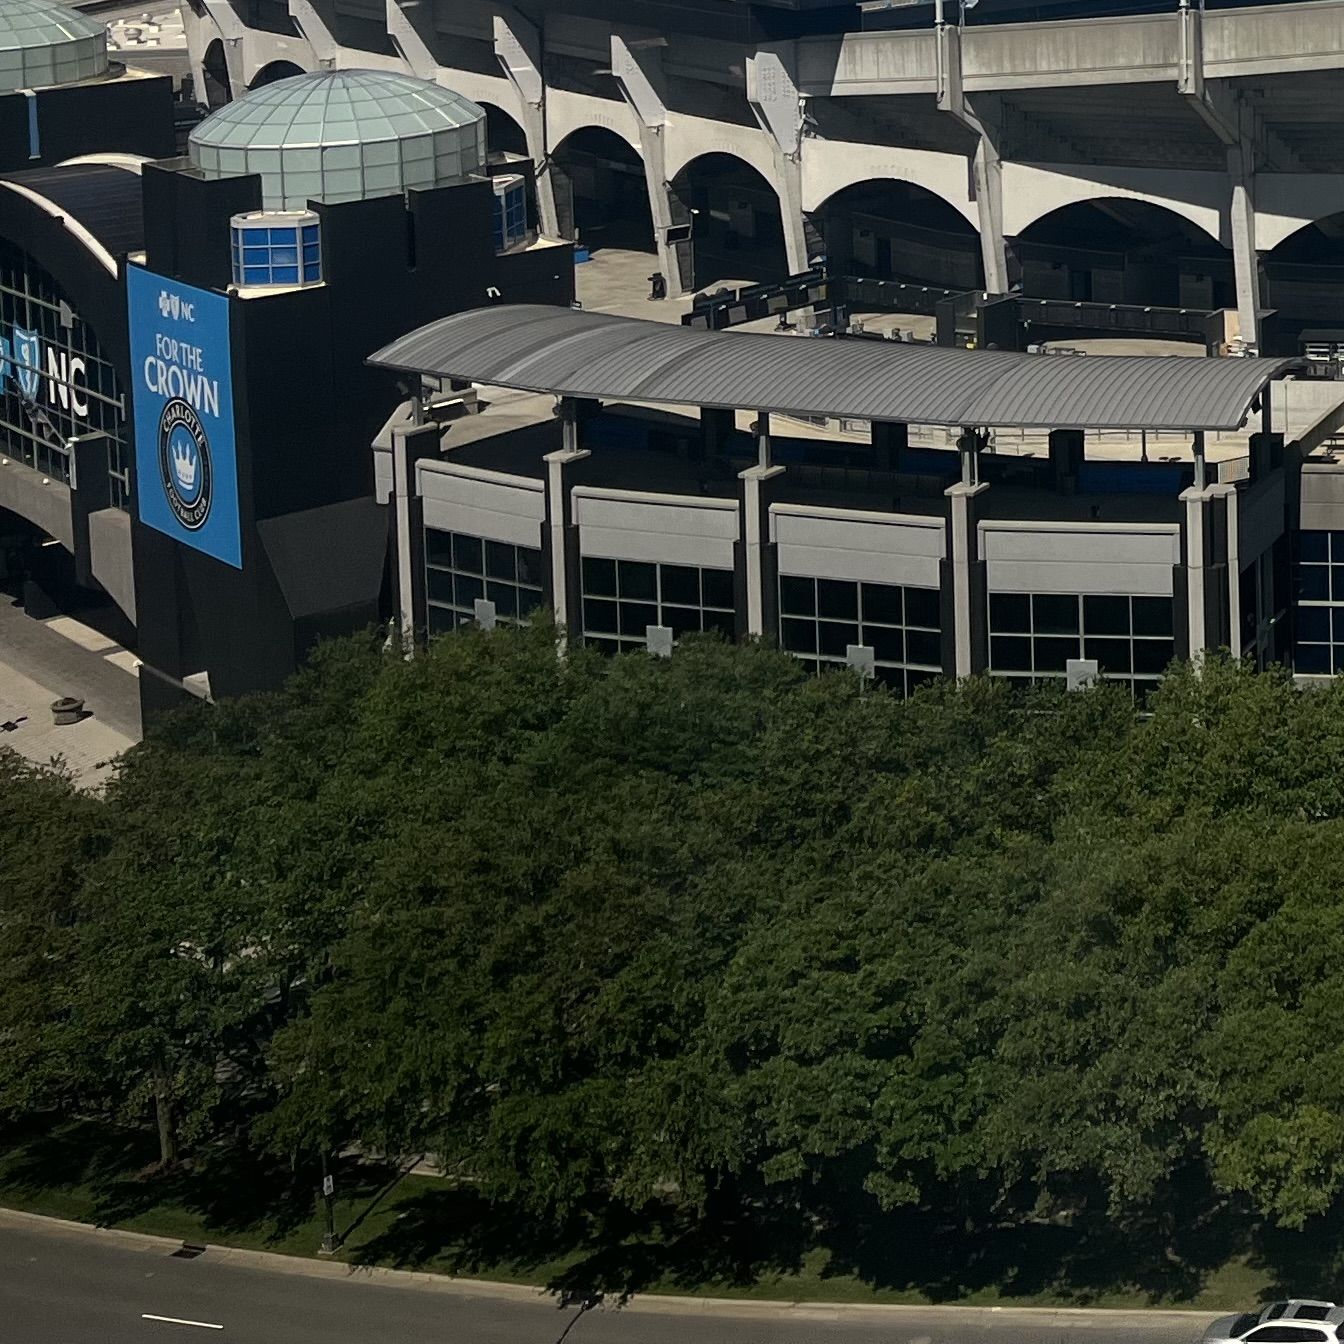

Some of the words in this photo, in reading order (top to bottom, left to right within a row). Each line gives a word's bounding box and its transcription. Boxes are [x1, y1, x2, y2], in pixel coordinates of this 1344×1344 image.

[181, 300, 196, 323] NC
[156, 333, 179, 364] FOR
[180, 342, 204, 372] THE
[47, 346, 89, 417] NC
[144, 355, 220, 418] CROWN
